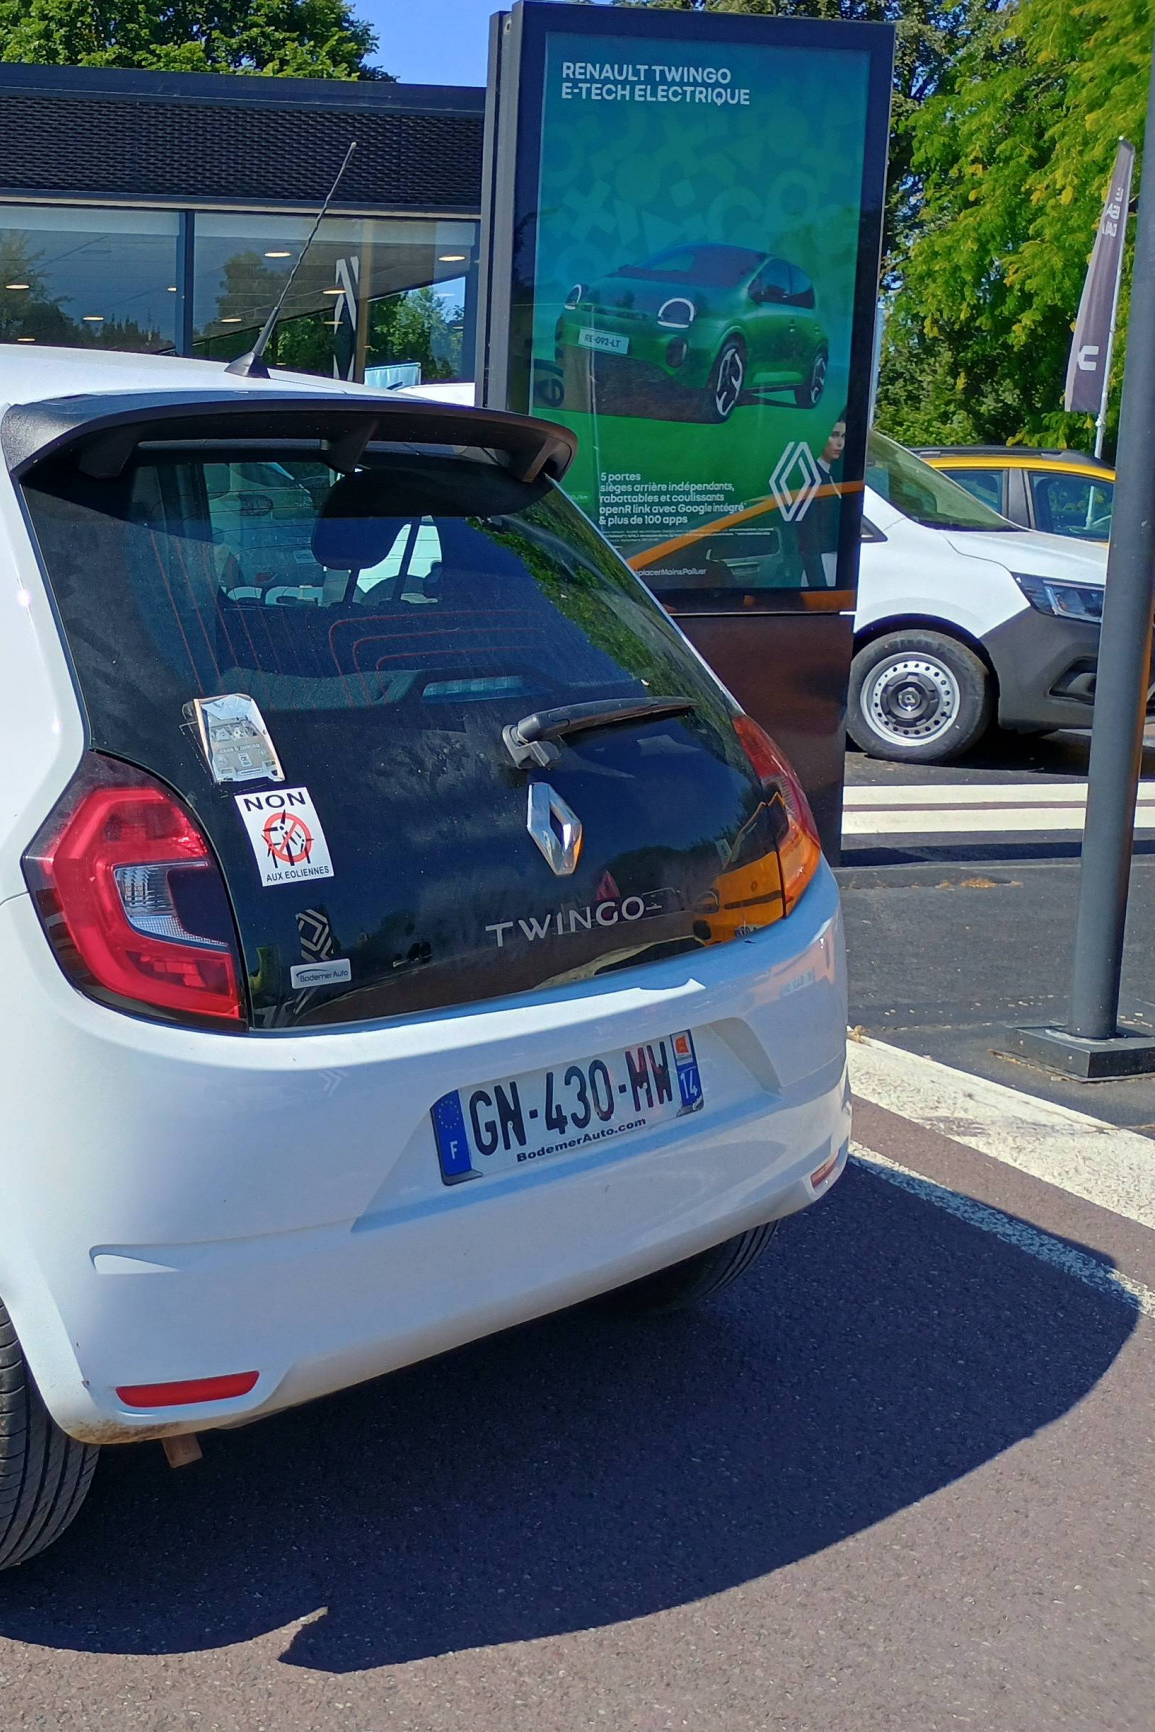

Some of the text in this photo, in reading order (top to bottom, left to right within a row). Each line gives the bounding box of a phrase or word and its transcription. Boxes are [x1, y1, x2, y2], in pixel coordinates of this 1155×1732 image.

[562, 62, 731, 84] RENAULT TWINGO
[561, 82, 750, 106] E-TECH ELECTRIQUE
[600, 472, 641, 485] 5 portes
[600, 481, 735, 494] sièges arrière indépendants,
[600, 493, 659, 503] rabattables
[660, 494, 671, 502] et
[671, 492, 725, 502] coulissants
[599, 504, 632, 517] openR
[632, 504, 651, 514] link
[652, 505, 676, 513] avec
[678, 504, 712, 515] Google
[599, 514, 688, 526] & plus de 100 apps
[243, 790, 306, 812] NON
[266, 866, 330, 882] AUX EOLIENNES
[485, 896, 645, 947] TWINGO
[680, 1069, 698, 1099] 14
[468, 1041, 674, 1157] GN-430-MW
[449, 1140, 459, 1160] F
[516, 1117, 647, 1163] BodemerAuto.com
